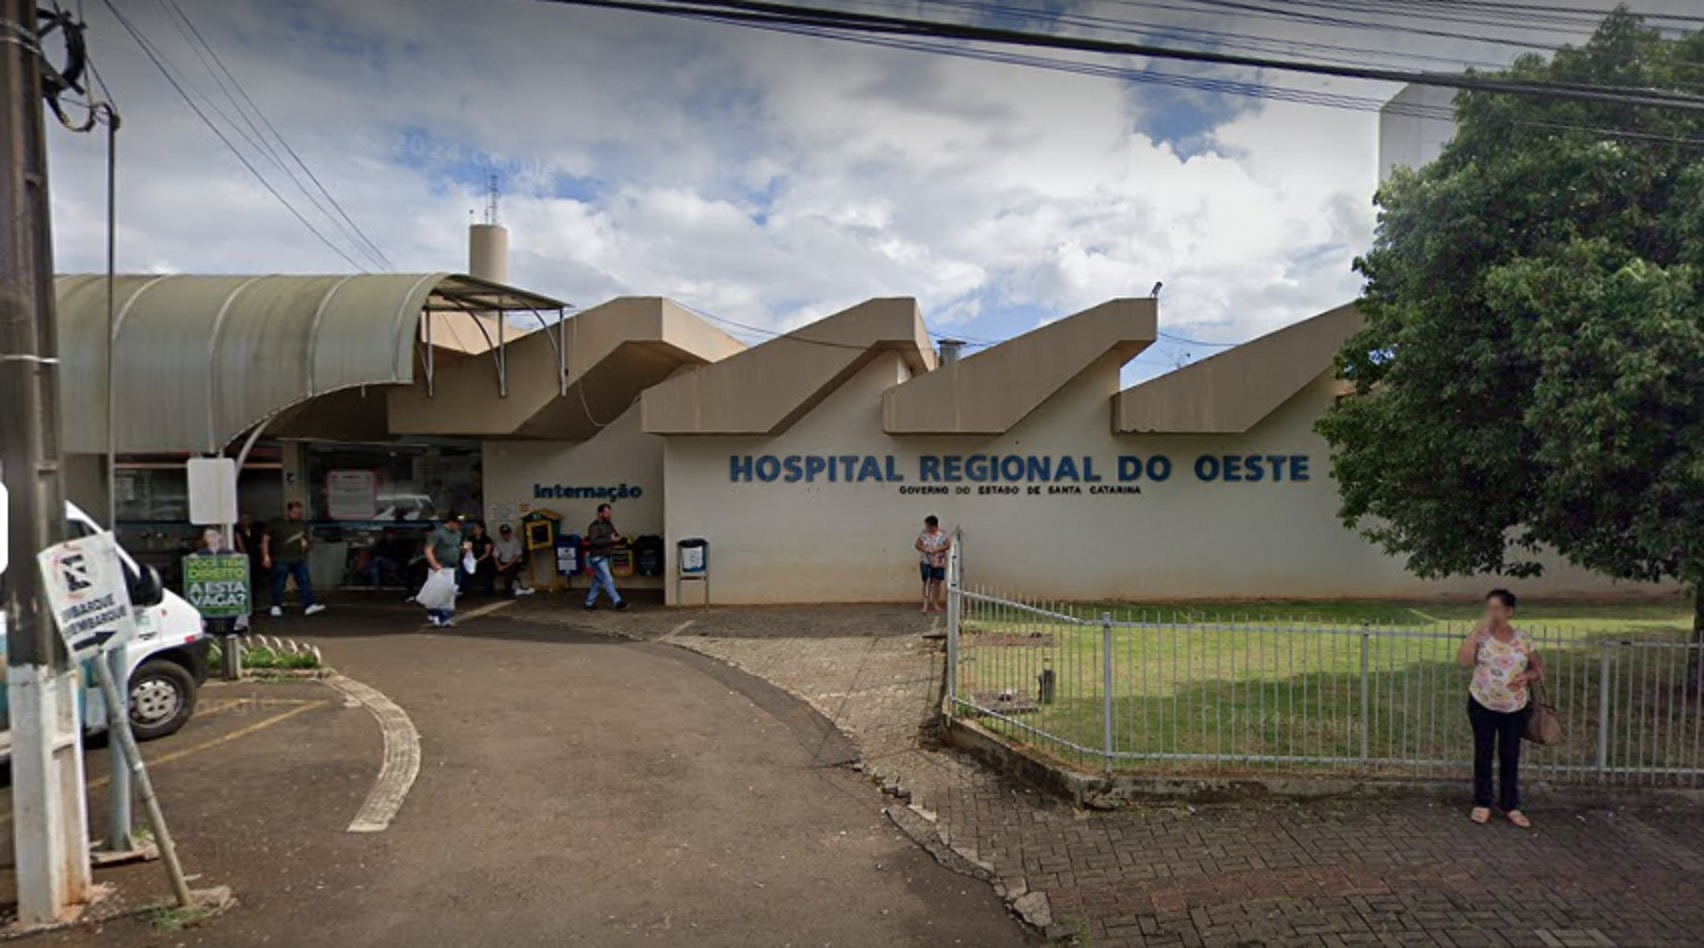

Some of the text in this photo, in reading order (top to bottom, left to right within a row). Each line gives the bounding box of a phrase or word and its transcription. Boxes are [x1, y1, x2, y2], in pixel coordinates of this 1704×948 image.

[730, 455, 1310, 482] HOSPITAL REGIONAL DO OESTE
[534, 484, 643, 503] Internação
[899, 485, 1142, 495] GOVERNO DO ESTADO DE SANTA CATARINA
[188, 568, 245, 579] DIREITO
[189, 582, 246, 593] A ESTA
[189, 593, 247, 607] VAGA?
